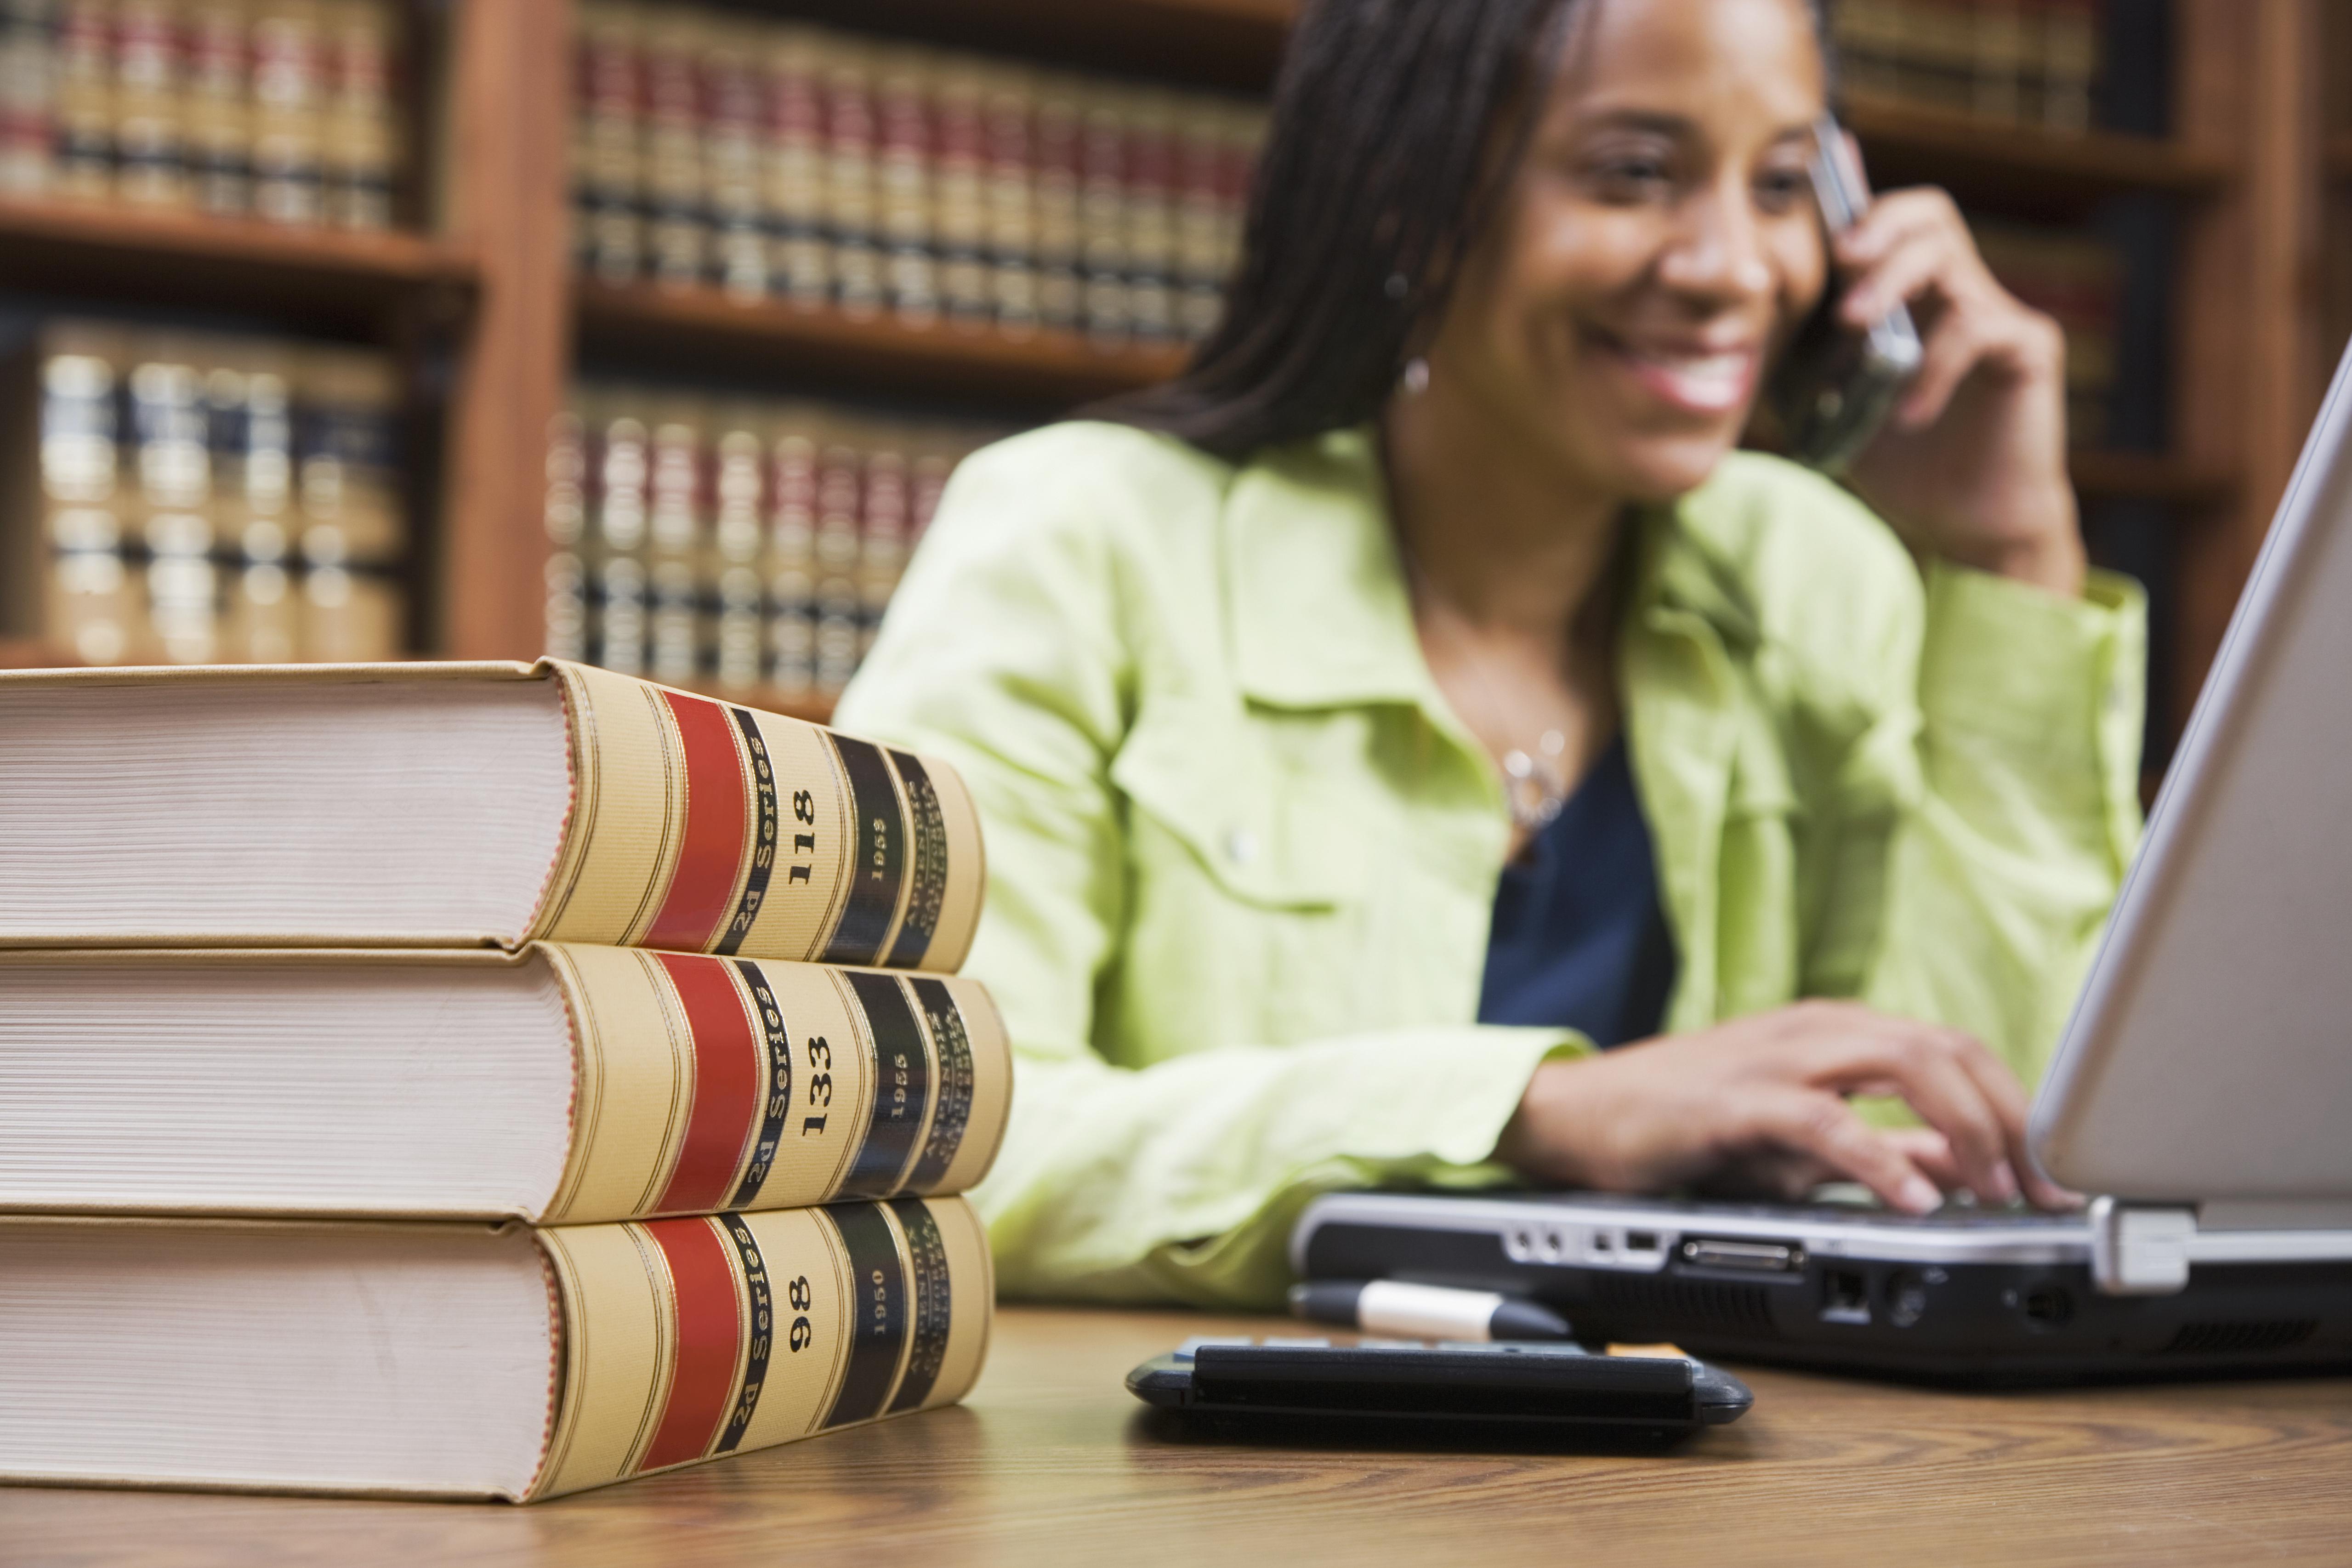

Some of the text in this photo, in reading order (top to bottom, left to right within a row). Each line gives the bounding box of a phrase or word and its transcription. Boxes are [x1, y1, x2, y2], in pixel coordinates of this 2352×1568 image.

[733, 736, 775, 932] 2d Series
[789, 790, 815, 885] 118
[748, 986, 788, 1184] 2d Series
[802, 1036, 832, 1137] 133
[891, 1054, 908, 1118] 1955
[733, 1227, 769, 1427] 2d Series
[789, 1275, 812, 1353] 98
[872, 1270, 886, 1335] 1950
